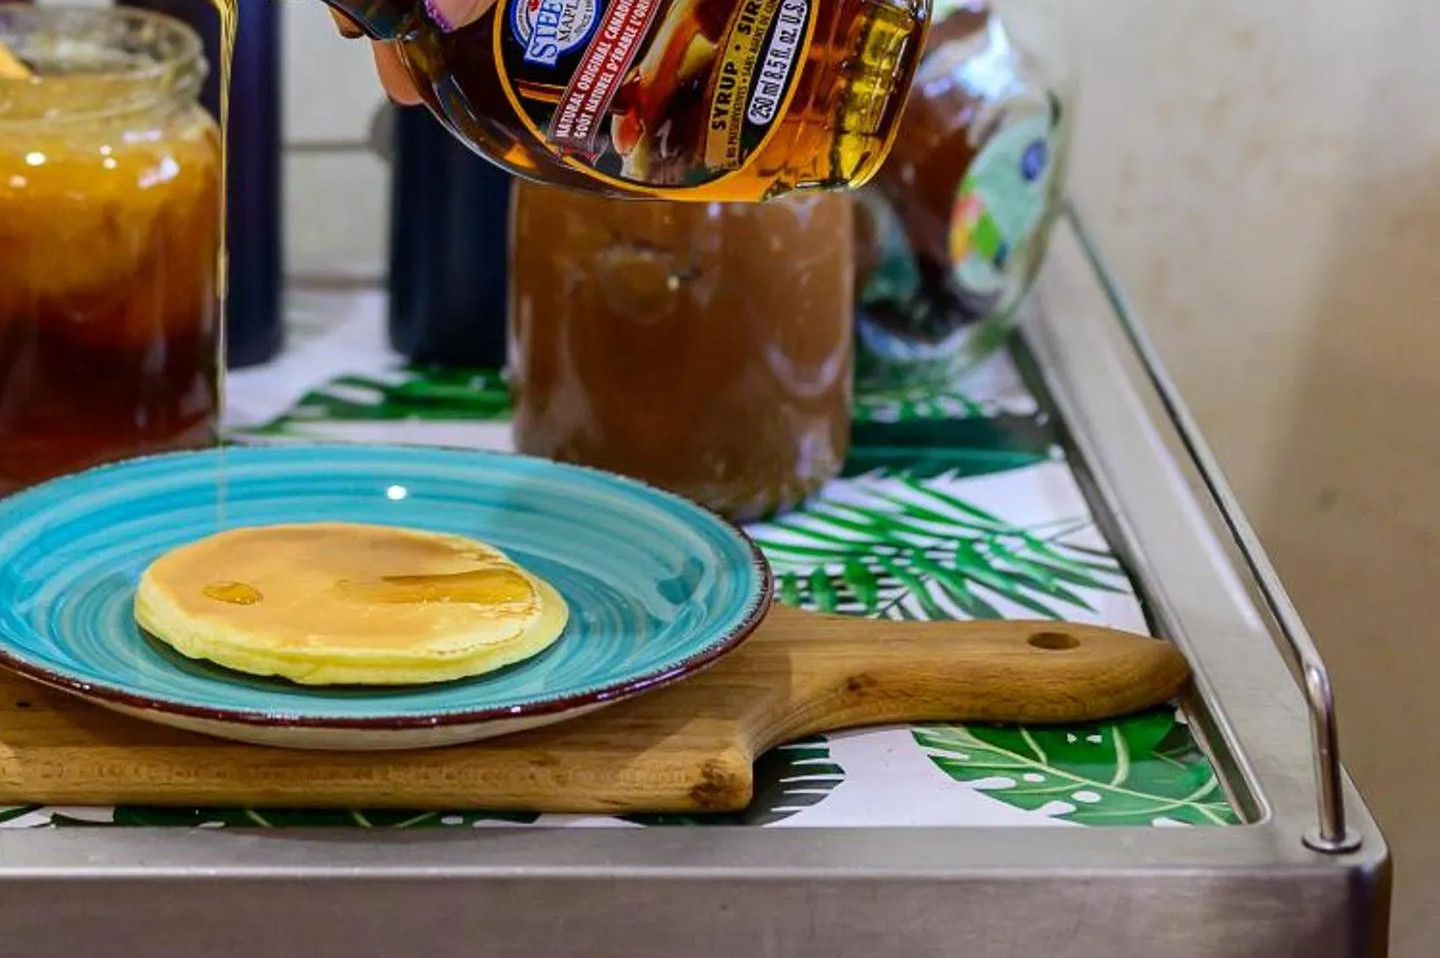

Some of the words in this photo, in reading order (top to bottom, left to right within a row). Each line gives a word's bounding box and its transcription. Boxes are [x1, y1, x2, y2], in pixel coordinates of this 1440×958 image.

[556, 92, 585, 137] NATURAL
[578, 42, 612, 90] ORIGINAL
[760, 81, 780, 96] ml
[764, 60, 787, 80] 8.5
[574, 113, 593, 138] GOÛT
[585, 72, 615, 112] NATUREL
[711, 61, 738, 131] SYRUP
[750, 97, 775, 119] 250
